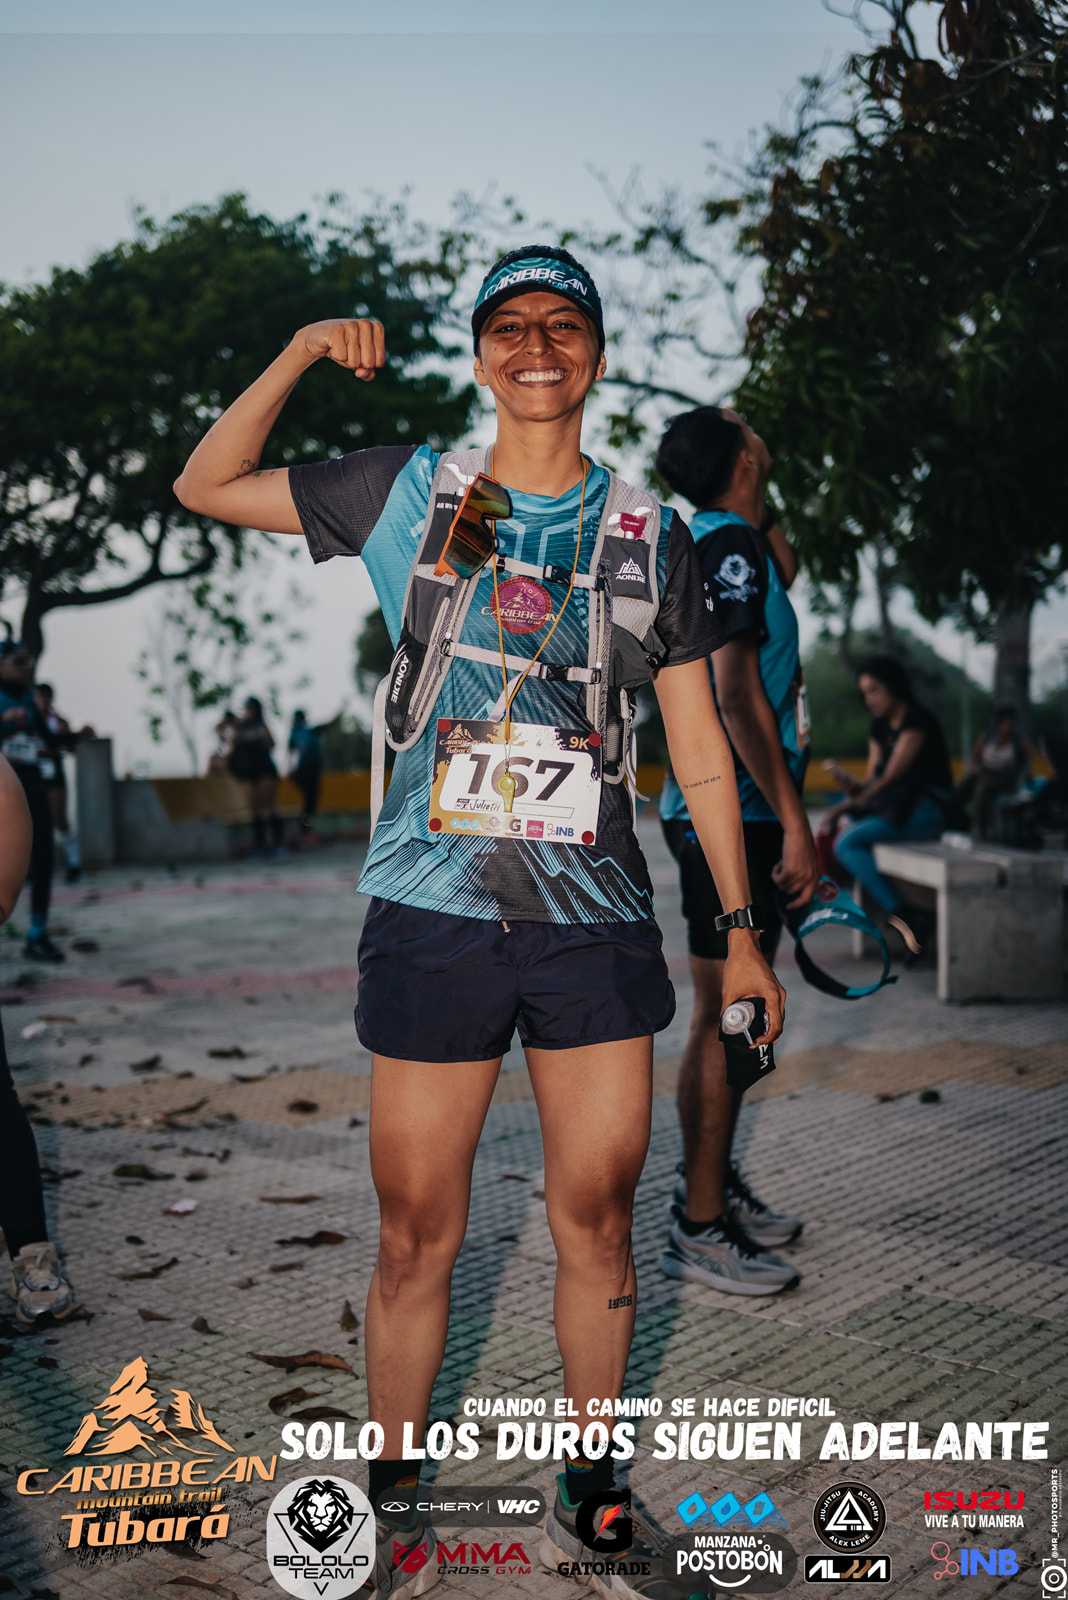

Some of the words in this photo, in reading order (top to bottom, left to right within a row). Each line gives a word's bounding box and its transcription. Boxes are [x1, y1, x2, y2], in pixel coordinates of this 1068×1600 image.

[484, 268, 588, 299] CARIBBEAN
[569, 736, 589, 750] 9K
[467, 753, 575, 801] 167
[555, 826, 575, 837] INB
